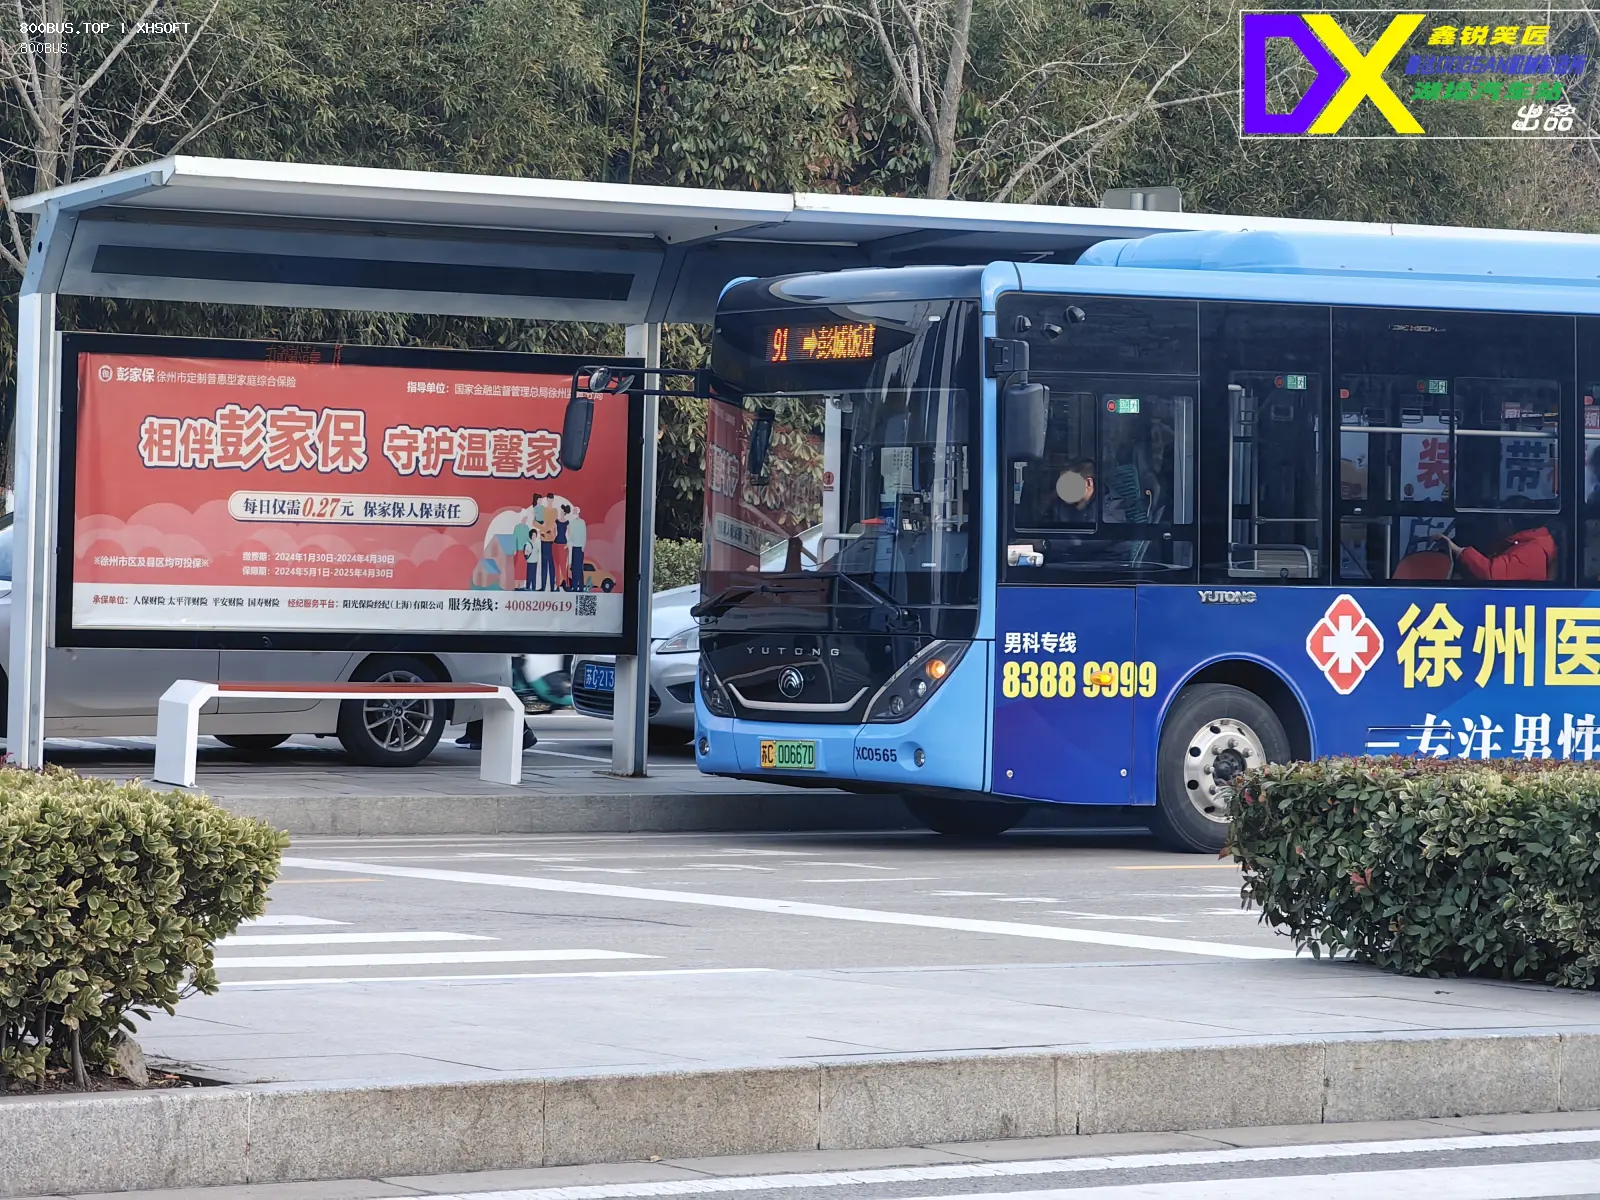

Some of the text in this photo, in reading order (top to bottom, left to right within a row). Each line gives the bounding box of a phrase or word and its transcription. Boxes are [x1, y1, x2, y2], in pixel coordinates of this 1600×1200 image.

[771, 328, 789, 362] 91
[116, 367, 155, 383] 彭家保
[156, 370, 297, 388] 徐州市定制普惠型家庭综合保险
[137, 403, 563, 479] 相伴彭家保 守护温馨家
[243, 497, 461, 519] 每日仅需0.27元 保家保人保责任
[504, 600, 573, 613] 4008209619
[1197, 590, 1258, 605] YUTONG
[745, 645, 840, 657] YUTONG
[1003, 631, 1077, 654] 男科专线
[1396, 602, 1600, 690] 徐州医
[1002, 660, 1158, 699] 8388 9999
